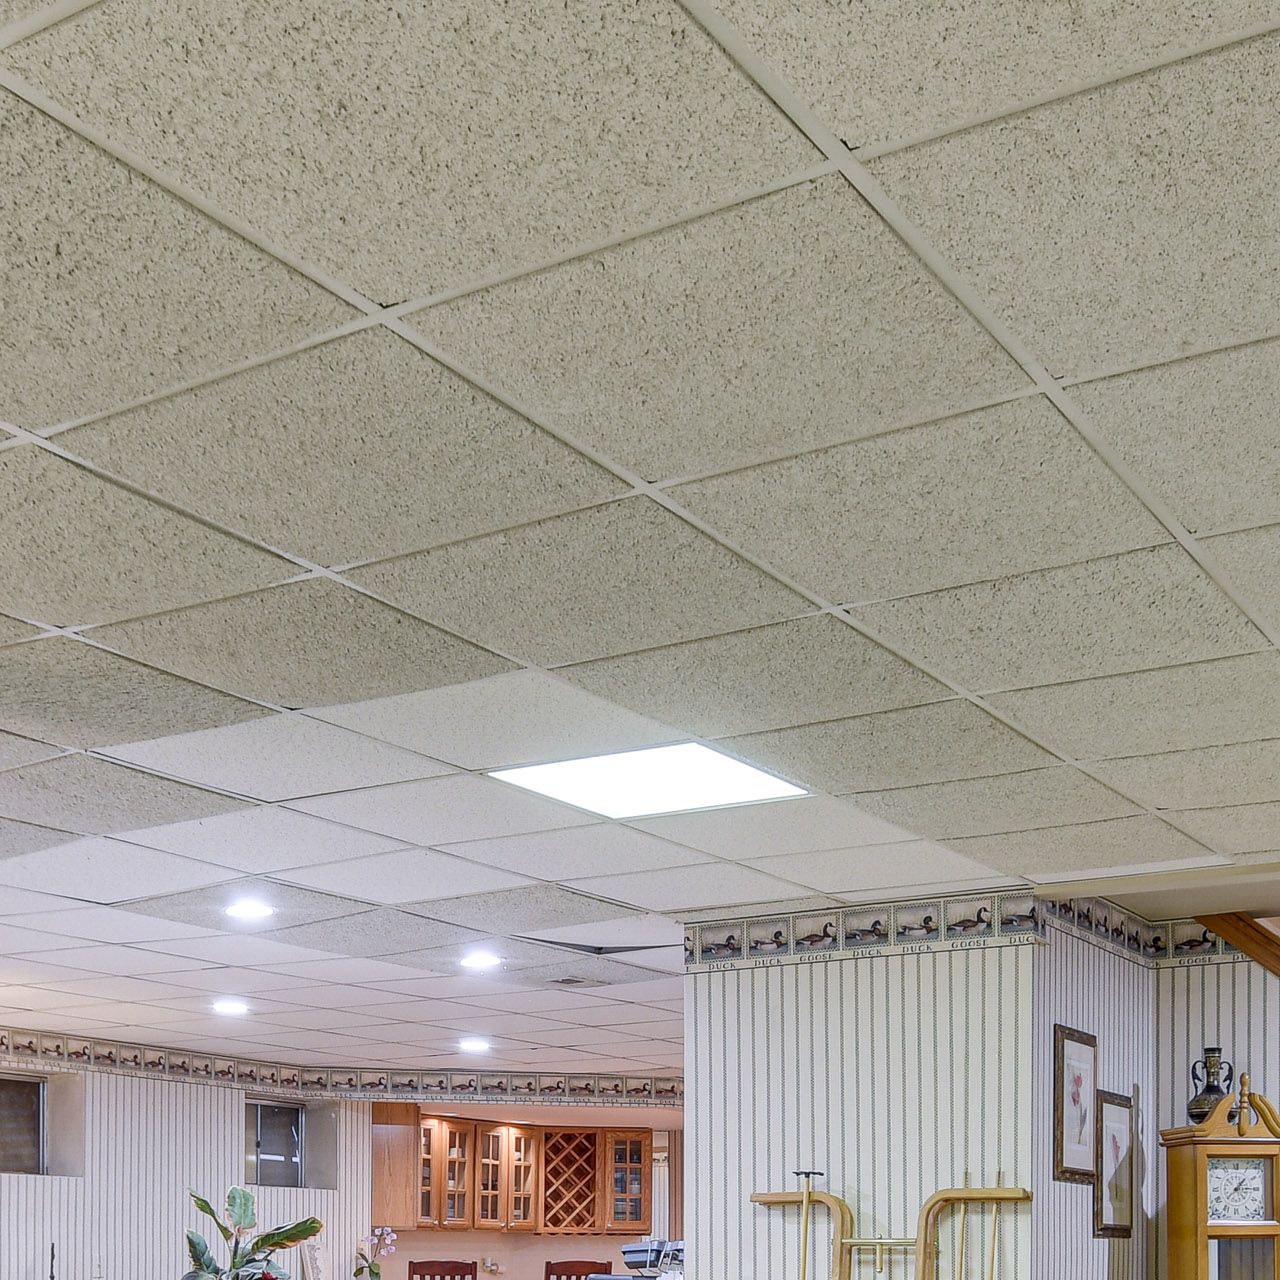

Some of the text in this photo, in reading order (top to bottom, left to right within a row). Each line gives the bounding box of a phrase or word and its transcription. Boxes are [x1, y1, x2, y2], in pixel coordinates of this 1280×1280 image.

[708, 962, 737, 972] DUCK
[754, 958, 783, 968] DUCK
[799, 952, 834, 963] GOOSE
[852, 948, 883, 958] DUCK
[902, 943, 933, 953] DUCK
[951, 939, 989, 949] GOOSE
[1179, 956, 1213, 966] GOOSE
